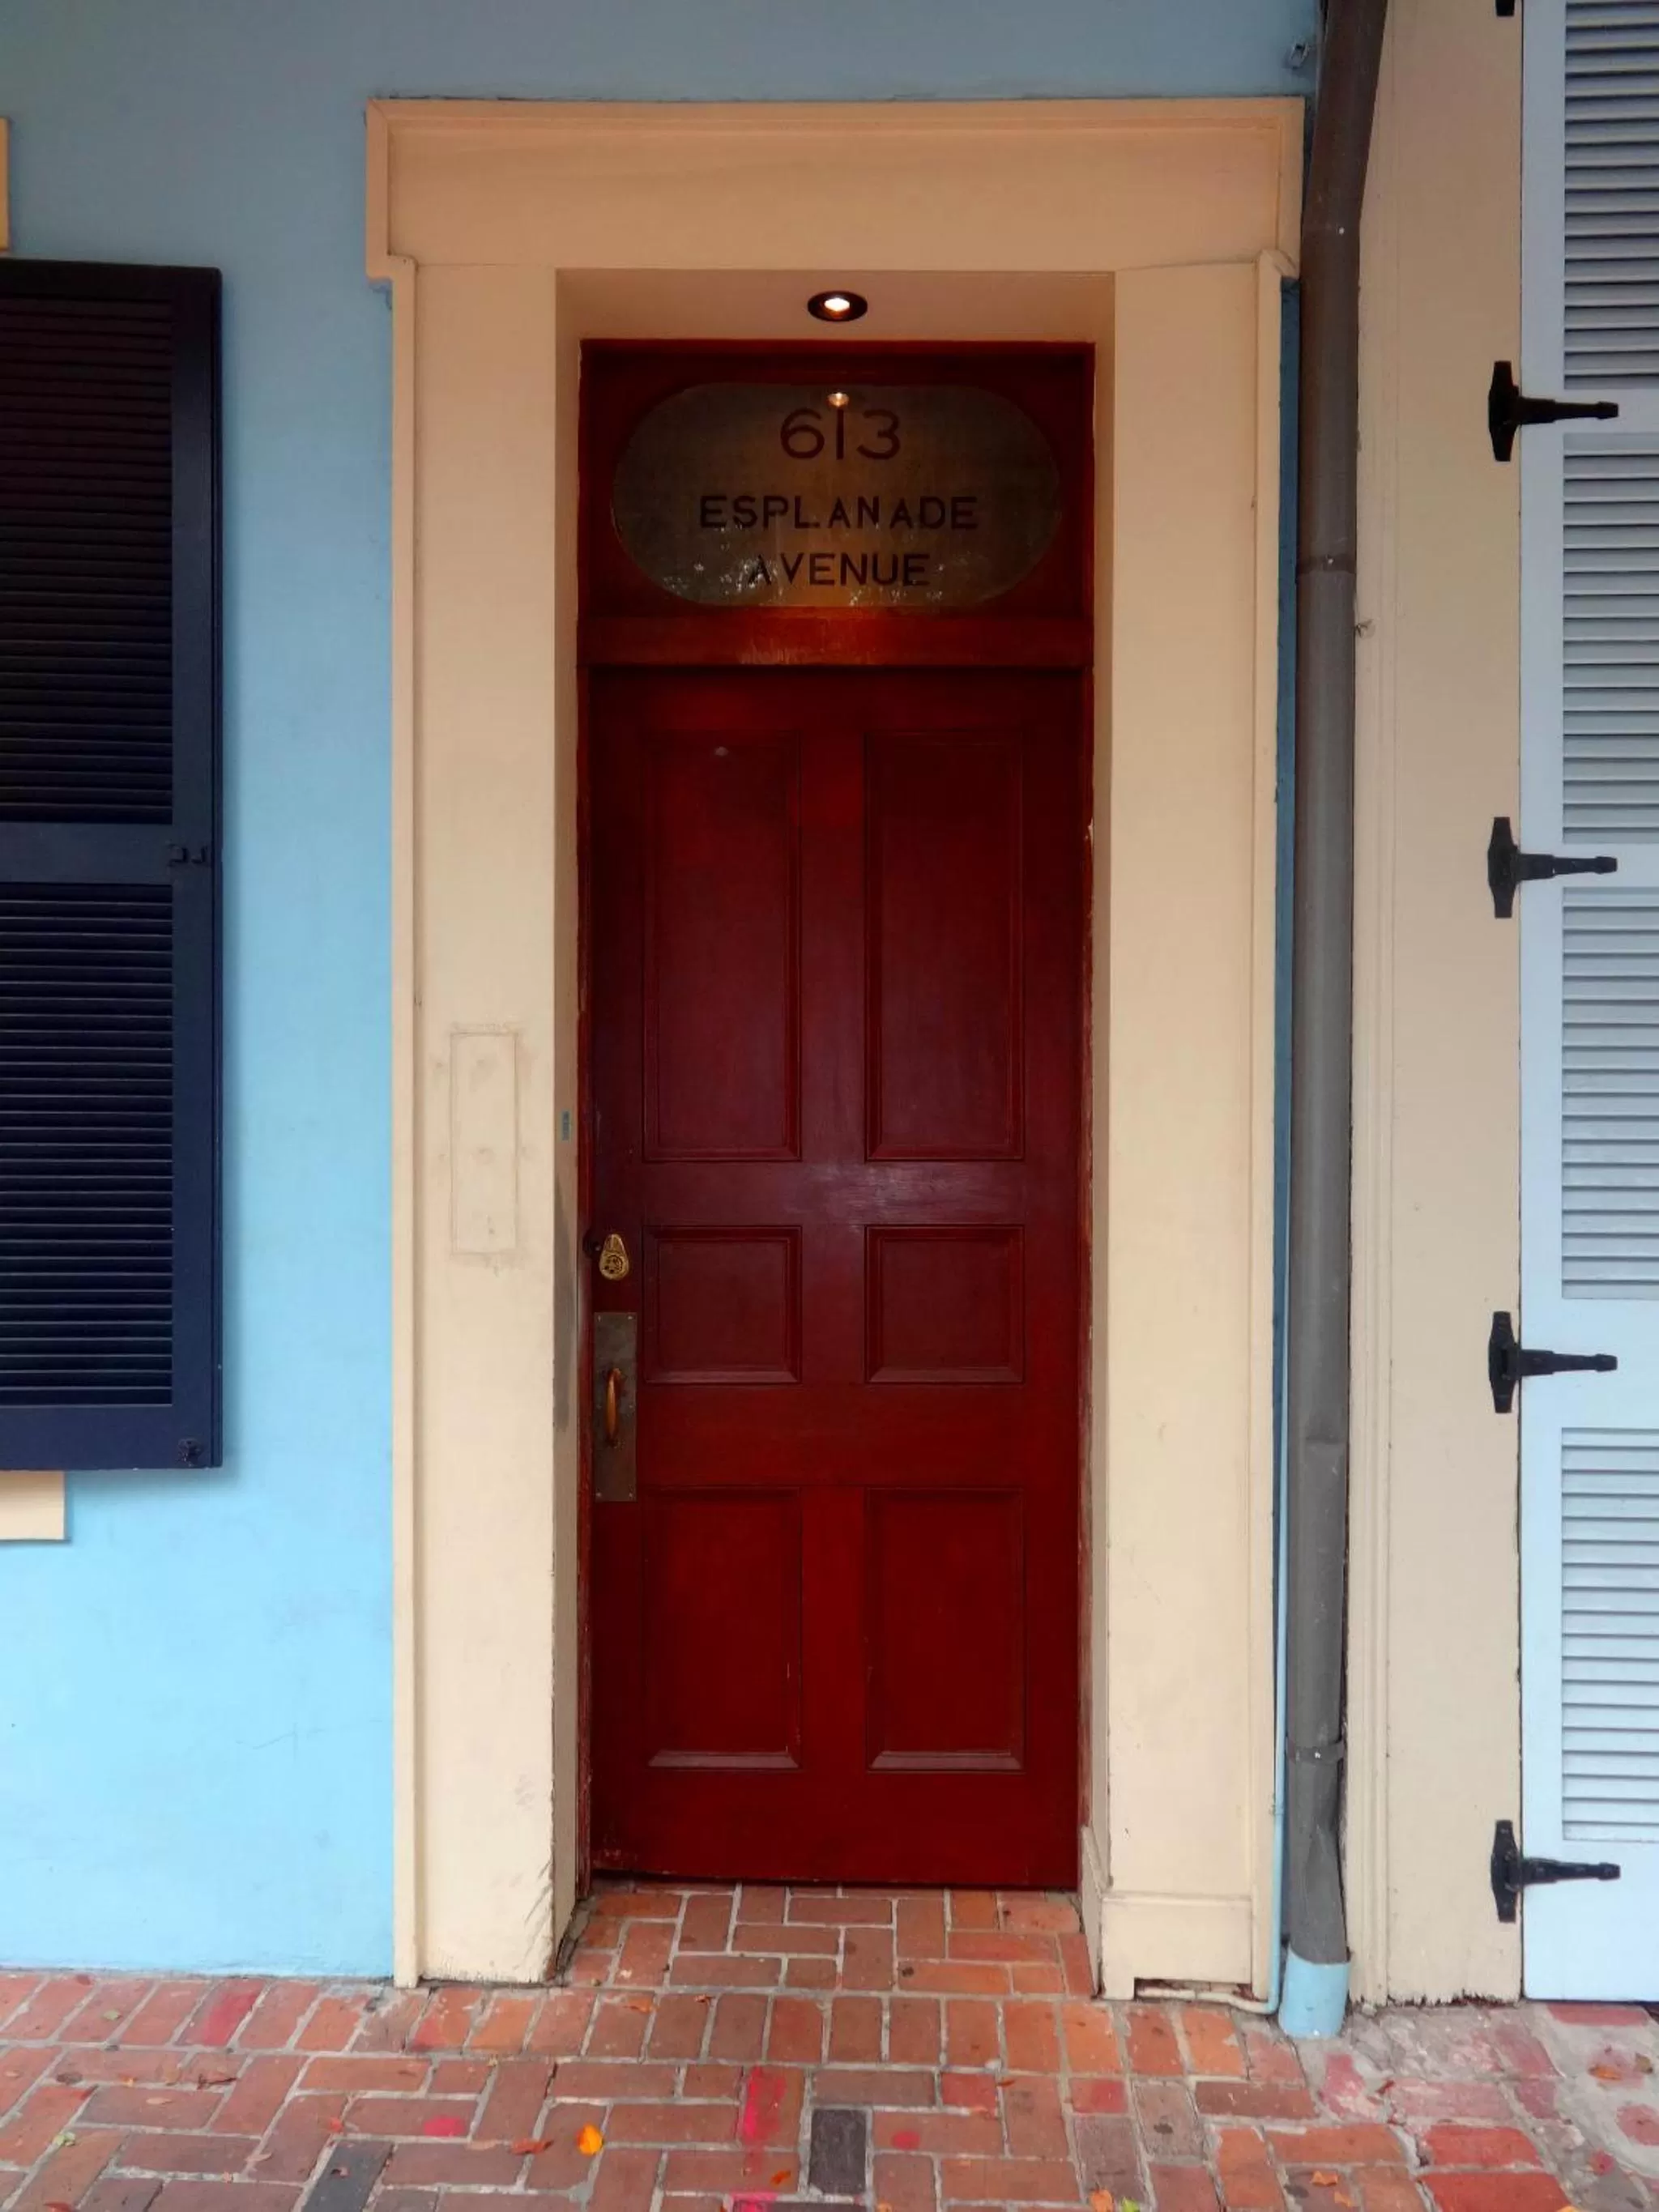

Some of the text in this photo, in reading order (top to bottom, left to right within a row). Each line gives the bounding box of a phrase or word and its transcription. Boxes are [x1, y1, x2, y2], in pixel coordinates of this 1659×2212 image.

[780, 409, 900, 460] 613
[700, 496, 978, 530] ESPLANADE
[747, 552, 931, 586] AVENUE
